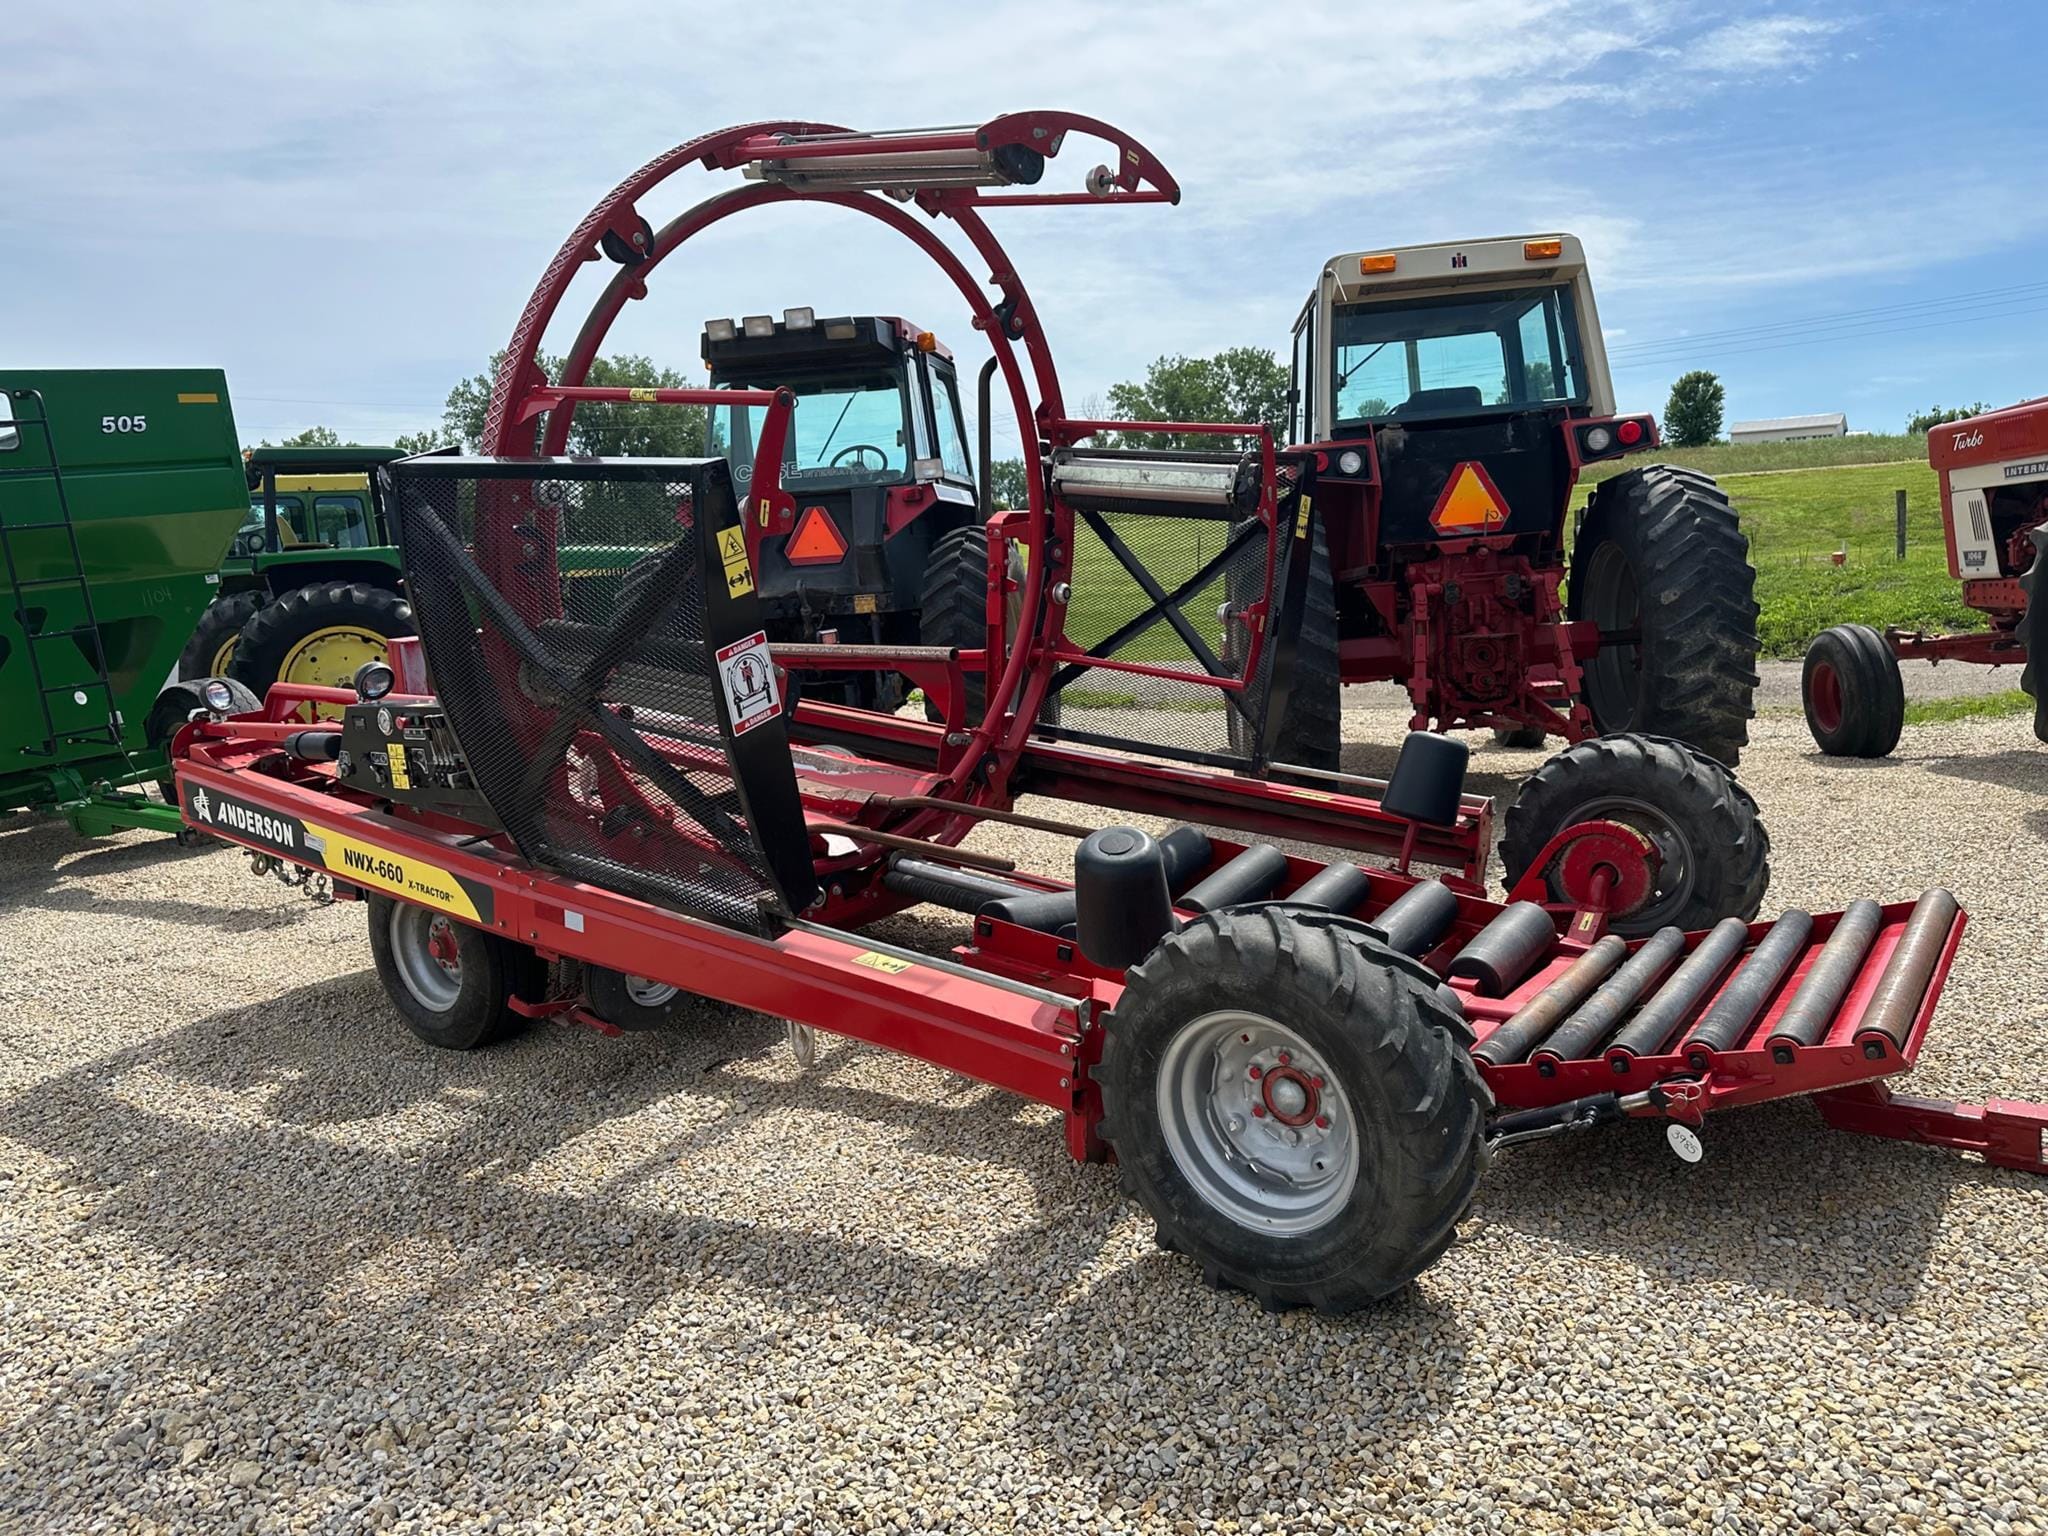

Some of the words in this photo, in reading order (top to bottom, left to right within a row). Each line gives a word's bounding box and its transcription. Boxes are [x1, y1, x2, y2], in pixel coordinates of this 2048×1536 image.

[102, 415, 147, 433] 505
[1952, 429, 1984, 451] Turbo
[733, 638, 756, 654] DANGER
[749, 708, 772, 726] DANGER
[217, 802, 294, 848] ANDERSON
[344, 847, 403, 884] NWX-660
